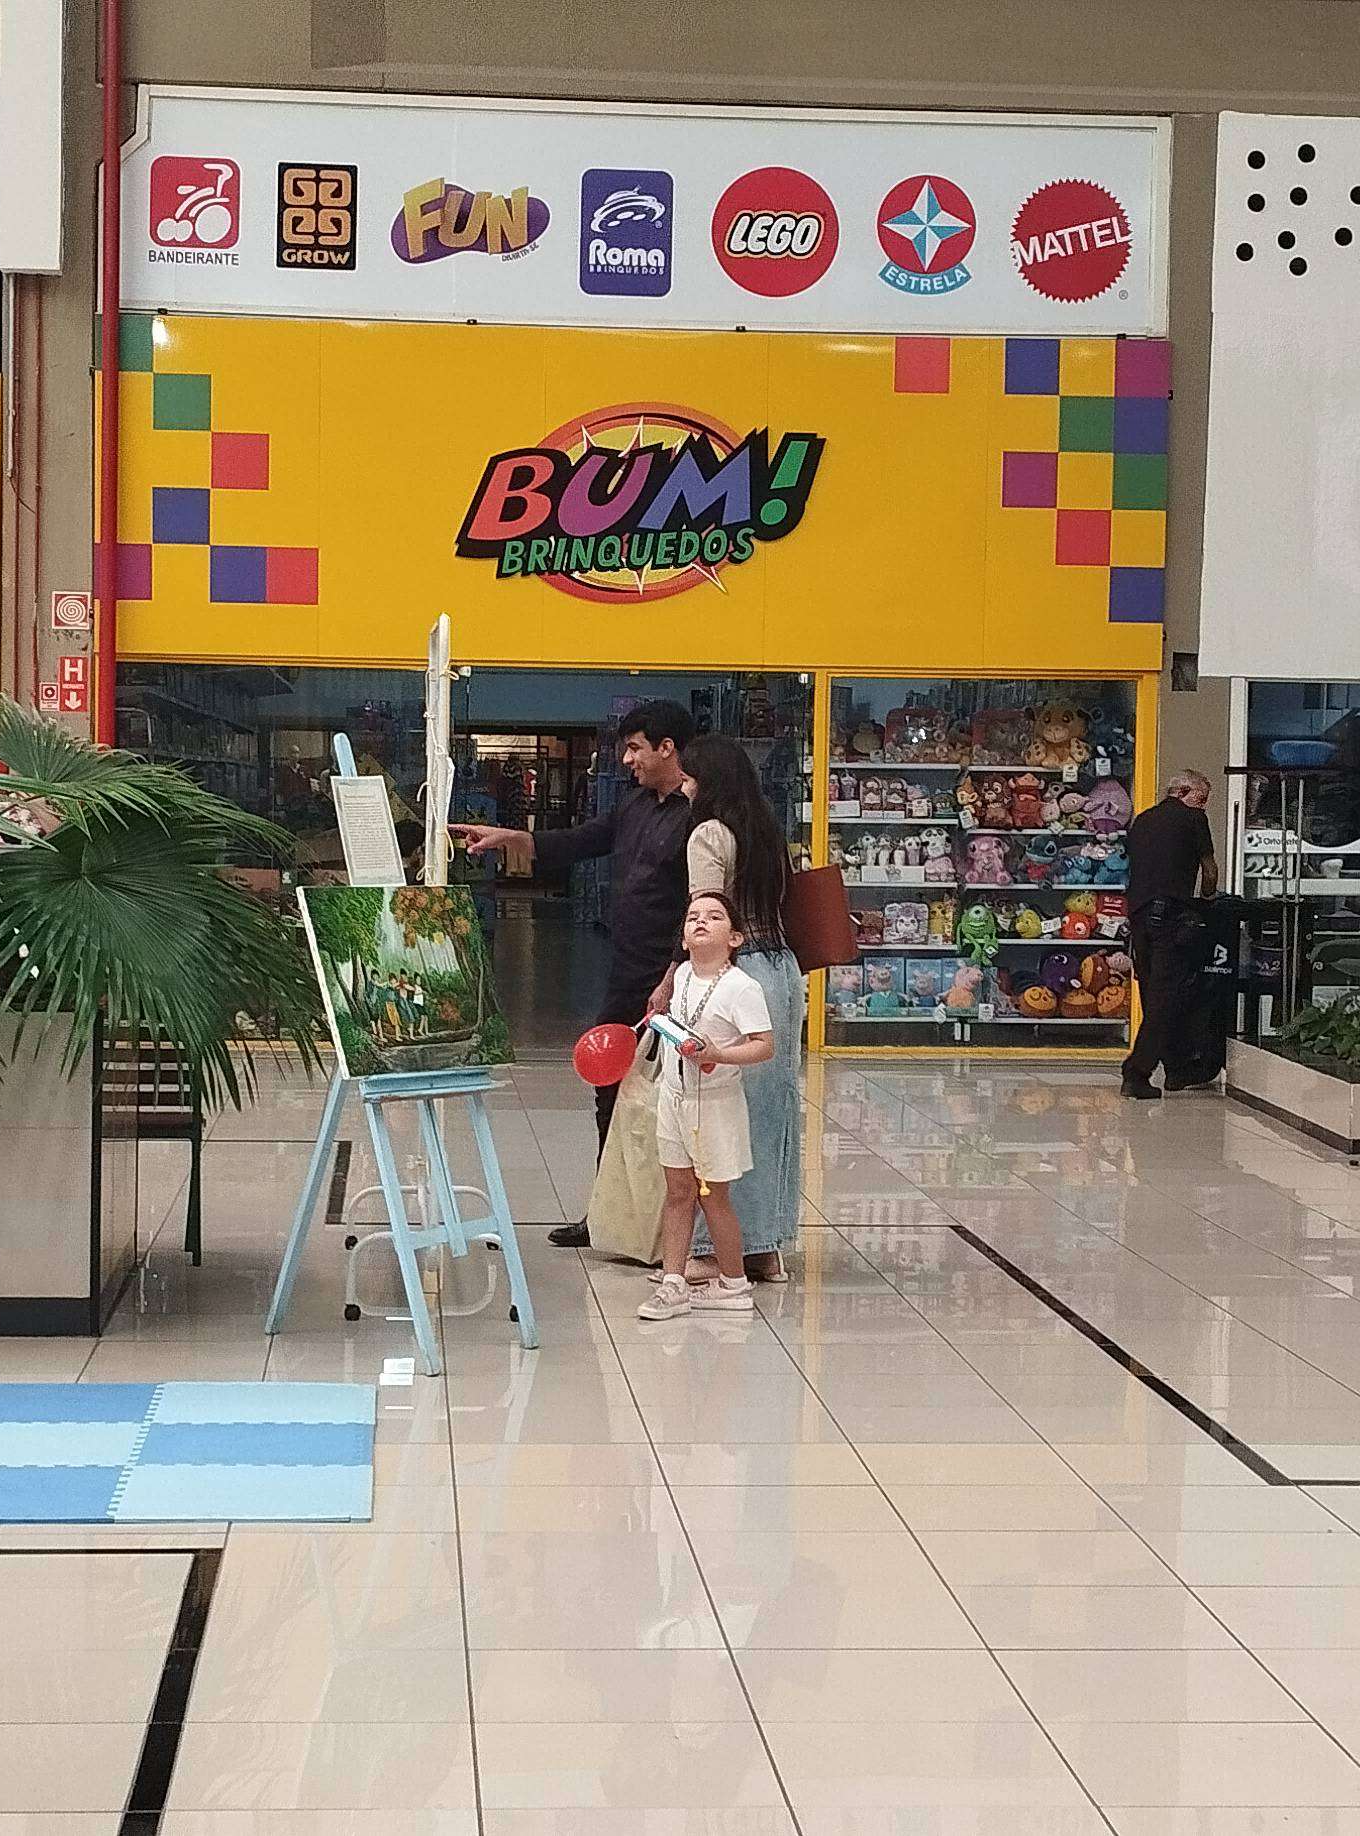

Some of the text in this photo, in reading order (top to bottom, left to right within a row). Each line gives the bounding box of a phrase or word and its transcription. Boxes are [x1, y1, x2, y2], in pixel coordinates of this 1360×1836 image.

[403, 177, 529, 259] FUN
[729, 216, 818, 254] LEGO
[1014, 215, 1130, 268] MATTEL
[148, 249, 239, 266] BANDEIRANTE
[281, 248, 351, 265] GROW
[589, 239, 665, 266] Roma
[884, 265, 968, 292] ESTRELA
[465, 437, 812, 542] BUM!
[501, 527, 756, 575] BRINQUEDOS
[64, 658, 83, 682] H
